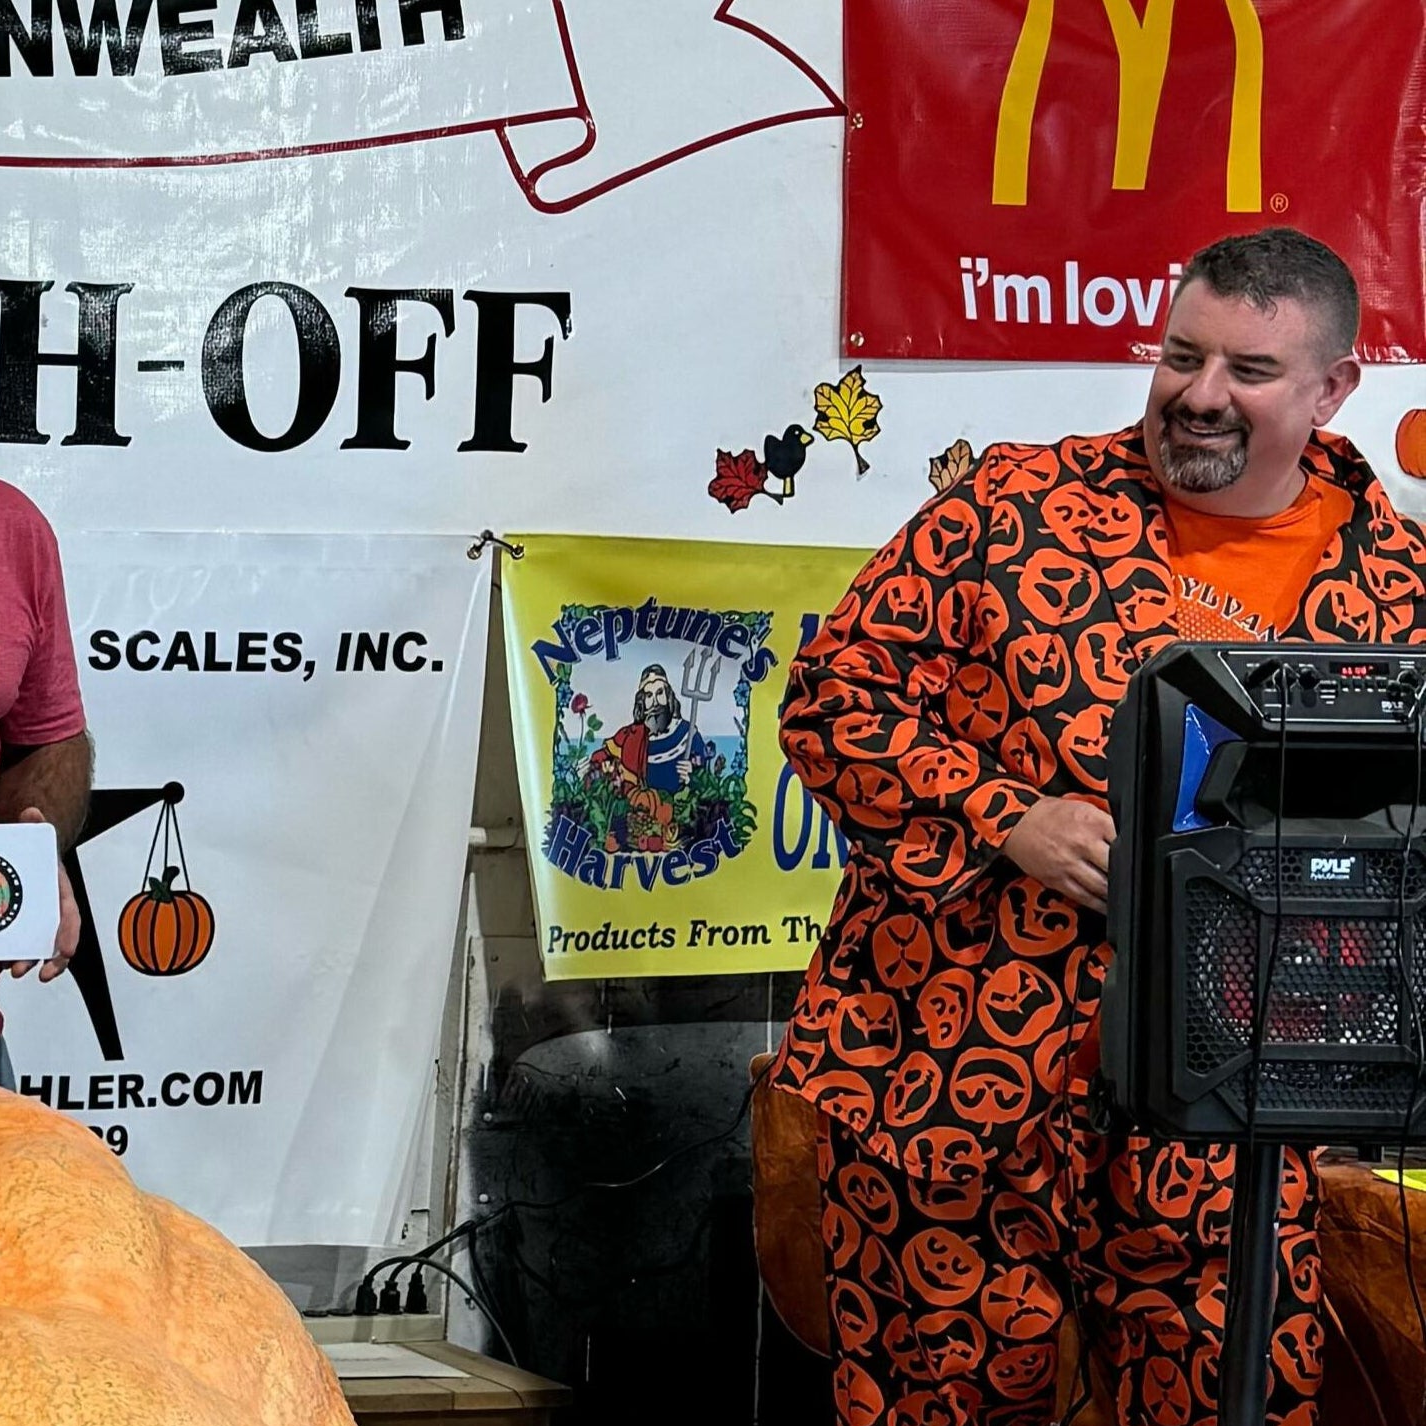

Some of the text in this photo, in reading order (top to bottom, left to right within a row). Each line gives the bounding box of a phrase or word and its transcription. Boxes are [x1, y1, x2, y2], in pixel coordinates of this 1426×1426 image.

[959, 256, 1052, 325] i'm
[88, 629, 444, 683] SCALES, INC.
[545, 813, 744, 893] Harvest
[1311, 858, 1351, 873] PYLE
[547, 915, 827, 953] Products From Th
